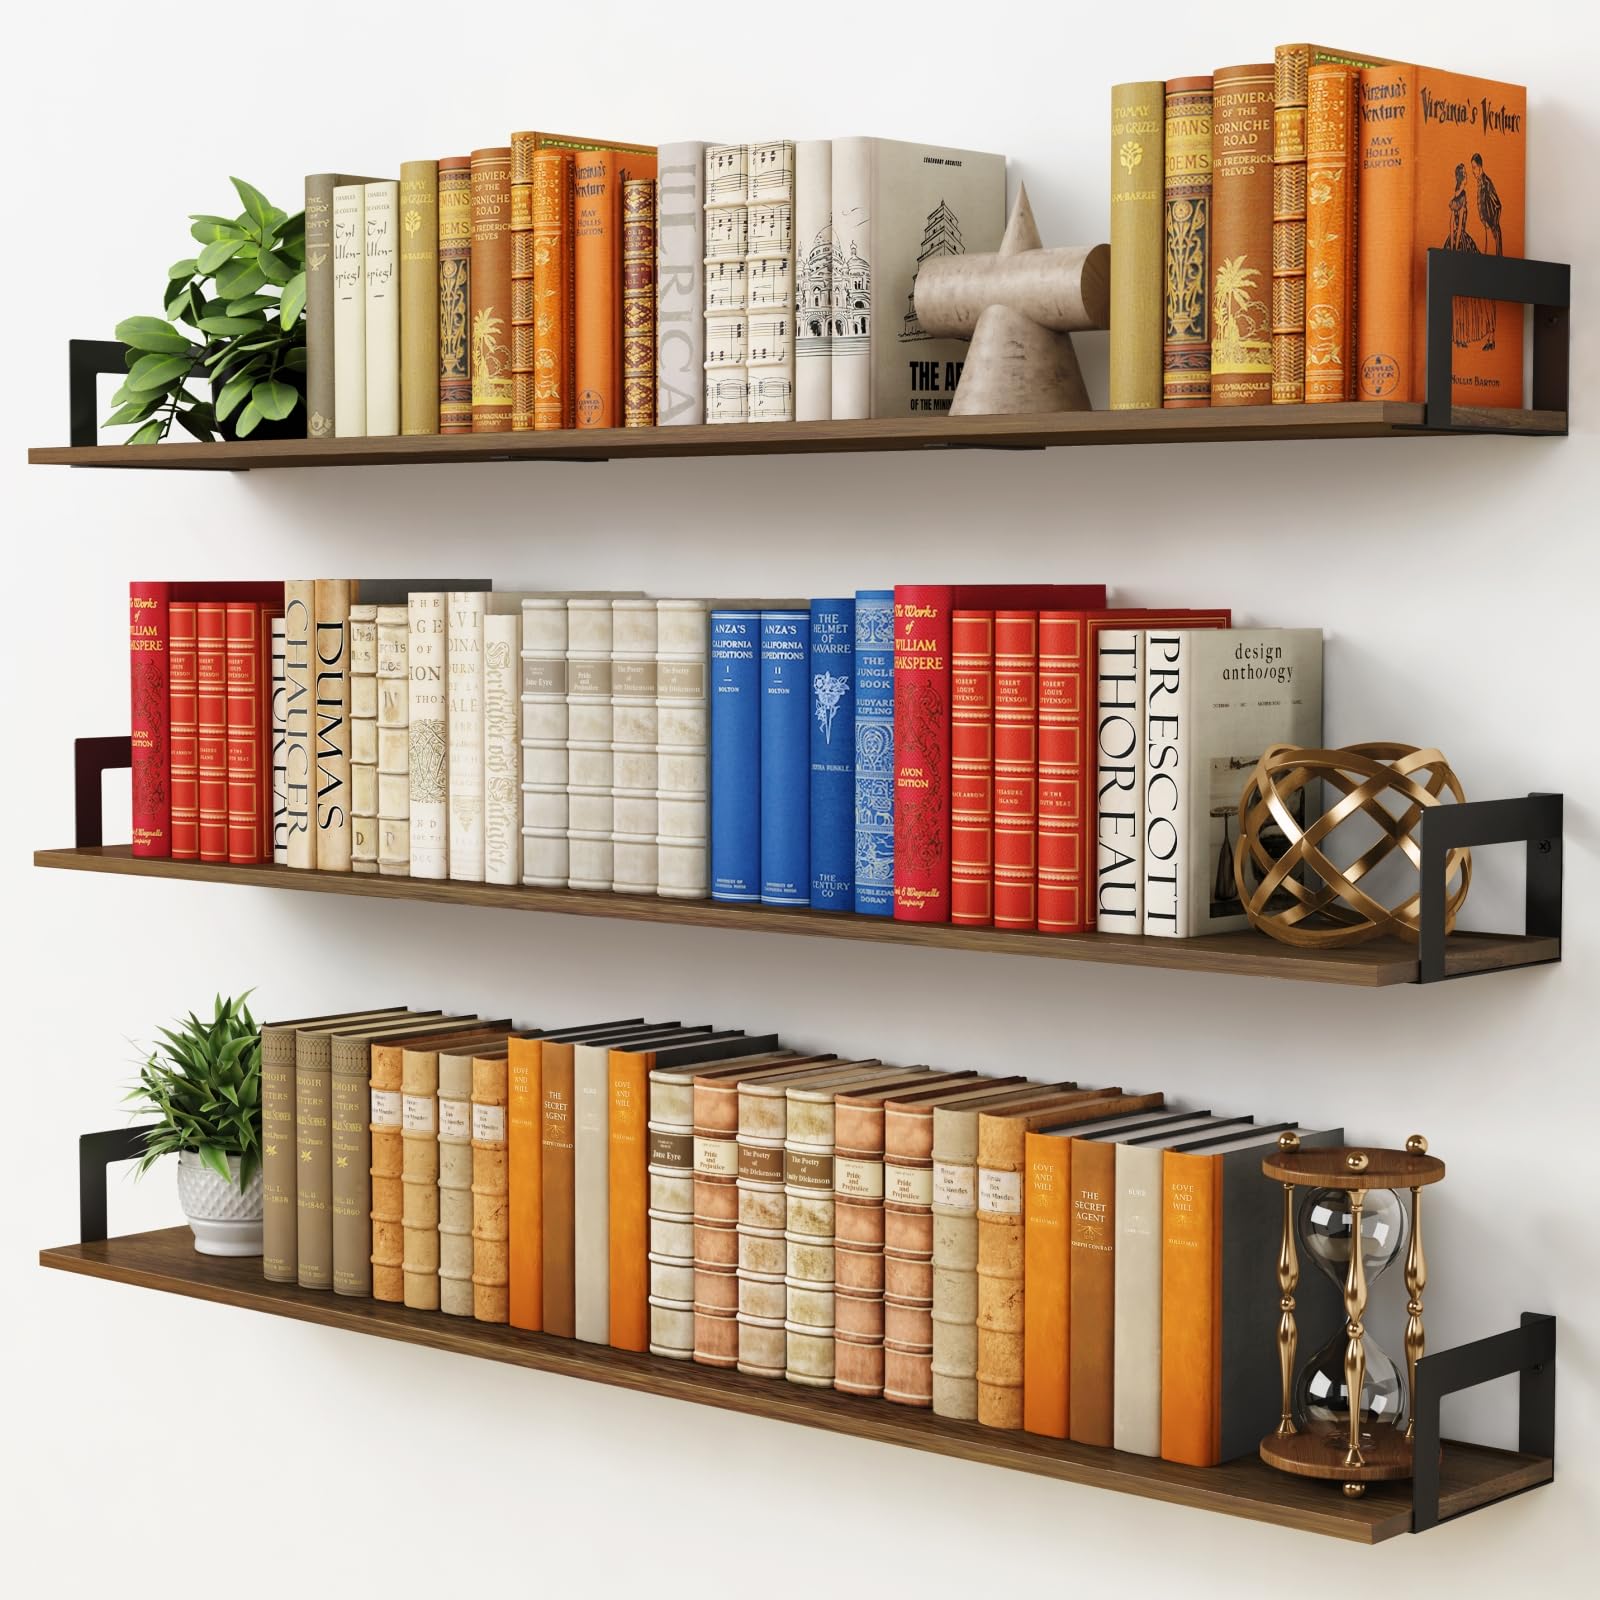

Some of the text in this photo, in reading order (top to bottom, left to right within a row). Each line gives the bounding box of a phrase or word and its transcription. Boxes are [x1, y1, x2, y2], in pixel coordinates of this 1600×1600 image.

[1222, 107, 1258, 118] OF THE
[1421, 86, 1521, 137] Virginia's Venture
[1214, 119, 1271, 136] CORNICHE
[1223, 134, 1258, 147] ROAD
[1371, 137, 1393, 145] MAY
[1367, 147, 1400, 158] HOLLIS
[1364, 158, 1402, 171] BARTON
[1221, 166, 1256, 178] TREVES
[476, 206, 501, 216] ROAD
[581, 210, 596, 218] MAY
[909, 361, 940, 391] THE
[910, 399, 919, 411] OF
[920, 399, 932, 411] THE
[409, 600, 440, 608] THE
[134, 610, 141, 623] of
[818, 613, 840, 624] THE
[715, 624, 747, 635] ANZA'S
[765, 625, 798, 635] ANZA'S
[813, 624, 849, 635] HELMET
[905, 620, 915, 635] of
[821, 633, 835, 644] OF
[416, 645, 433, 654] OF
[1235, 642, 1282, 664] design
[863, 656, 886, 666] THE
[857, 667, 894, 678] JUNGLE
[860, 680, 891, 690] BOOK
[858, 707, 892, 716] KIPLING
[287, 600, 309, 840] CHAUCER
[317, 621, 344, 831] DUMAS
[901, 768, 924, 777] AVON
[1099, 634, 1138, 920] THOREAU
[1147, 636, 1181, 935] PRESCOTT
[819, 873, 837, 882] THE
[812, 881, 851, 893] CENTURY
[821, 890, 834, 899] CO
[861, 896, 888, 905] DORAN
[550, 1091, 562, 1100] THE
[544, 1100, 568, 1112] SECRET
[546, 1111, 568, 1122] AGENT
[653, 1149, 682, 1162] Jane Eyre
[743, 1149, 771, 1161] The Poetry
[792, 1155, 820, 1168] The Poetry
[1033, 1163, 1055, 1173] LOVE
[799, 1174, 832, 1185] Dickenson
[847, 1171, 862, 1180] Pride
[1034, 1172, 1053, 1182] AND
[848, 1178, 860, 1186] and
[897, 1179, 912, 1188] Pride
[1034, 1182, 1053, 1192] WILL
[1172, 1183, 1194, 1194] LOVE
[1081, 1189, 1099, 1201] THE
[1174, 1192, 1193, 1203] AND
[1074, 1200, 1106, 1213] SECRET
[1172, 1202, 1193, 1213] WILL
[1076, 1211, 1106, 1224] AGENT
